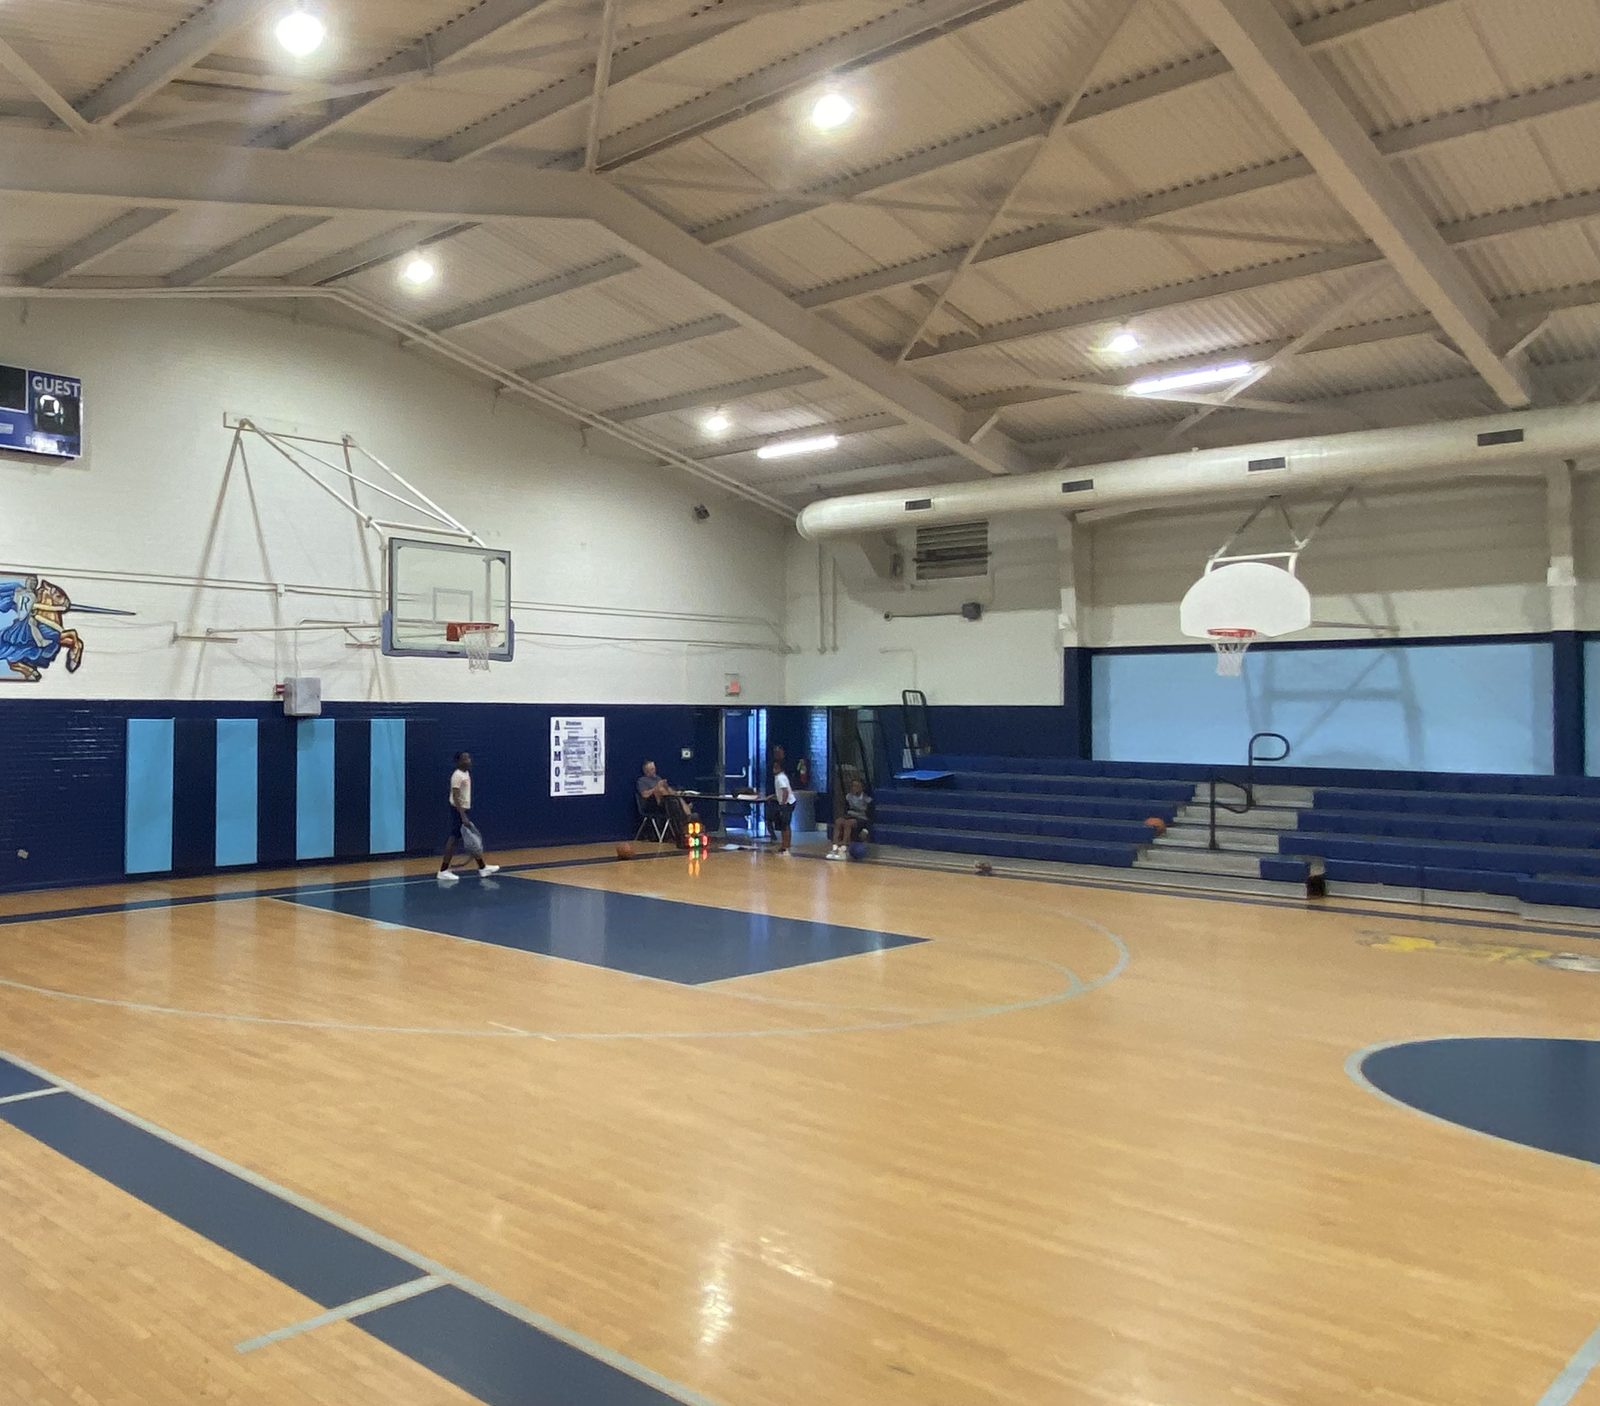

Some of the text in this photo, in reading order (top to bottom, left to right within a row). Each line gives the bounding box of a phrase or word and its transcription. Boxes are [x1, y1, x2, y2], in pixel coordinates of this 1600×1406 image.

[32, 375, 80, 398] GUEST
[20, 596, 31, 612] R
[553, 719, 562, 793] ARMOR
